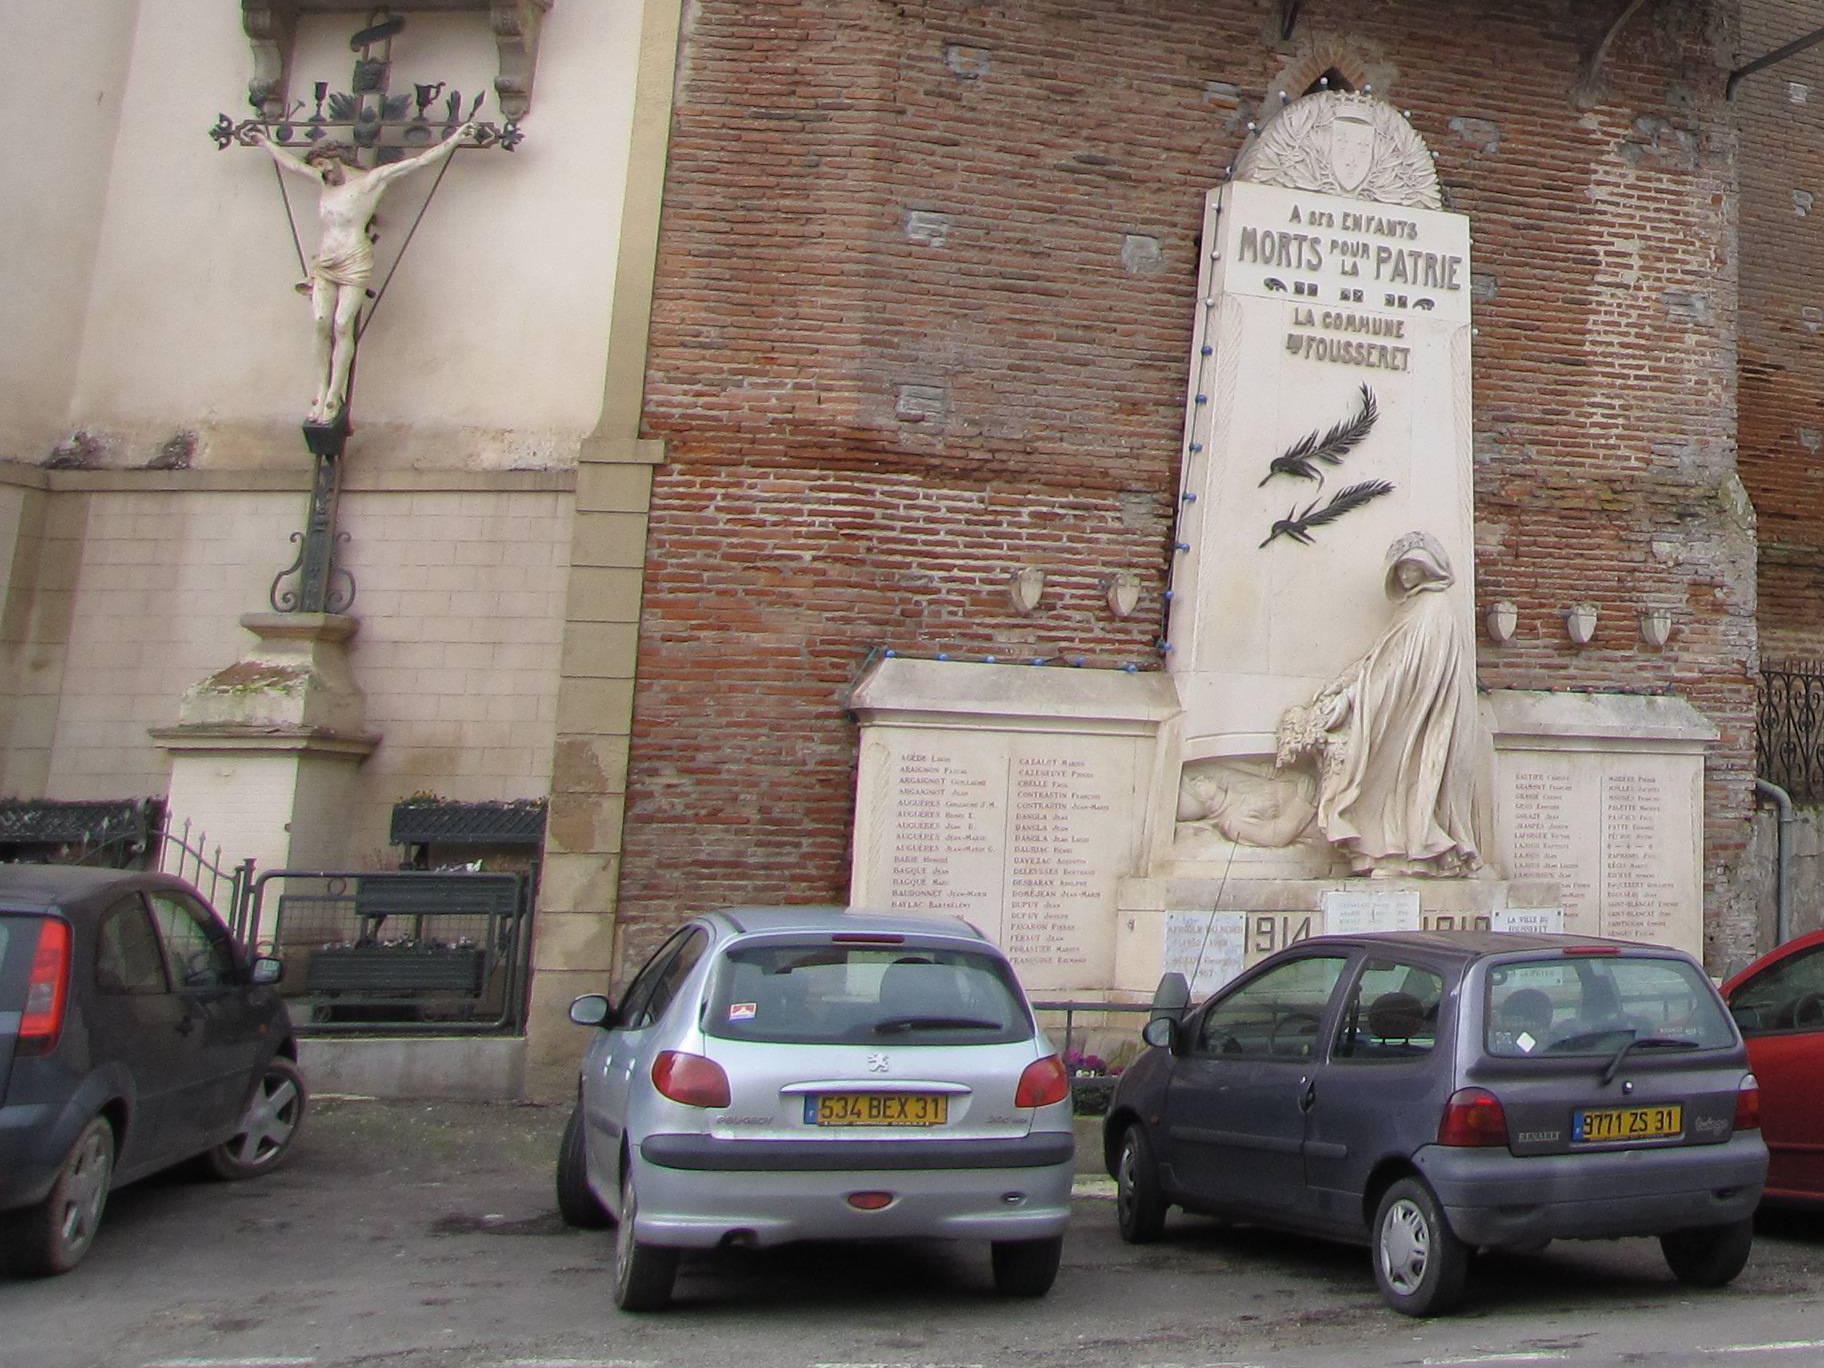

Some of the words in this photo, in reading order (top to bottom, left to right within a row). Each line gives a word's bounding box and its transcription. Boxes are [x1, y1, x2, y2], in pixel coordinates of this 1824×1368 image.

[1289, 204, 1302, 224] A
[1308, 210, 1334, 229] SES
[1341, 211, 1418, 240] ENFANTS
[1238, 225, 1323, 272] MORTS
[1329, 239, 1370, 261] POUR
[1341, 259, 1360, 277] LA
[1375, 244, 1464, 292] PATRIE
[1293, 307, 1316, 327] LA
[1322, 310, 1406, 339] COMMUNE
[820, 1095, 863, 1120] 534
[868, 1095, 909, 1120] BEX
[915, 1095, 940, 1120] 31
[1583, 1110, 1623, 1137] 9771
[1629, 1110, 1649, 1134] ZS
[1654, 1107, 1675, 1130] 31
